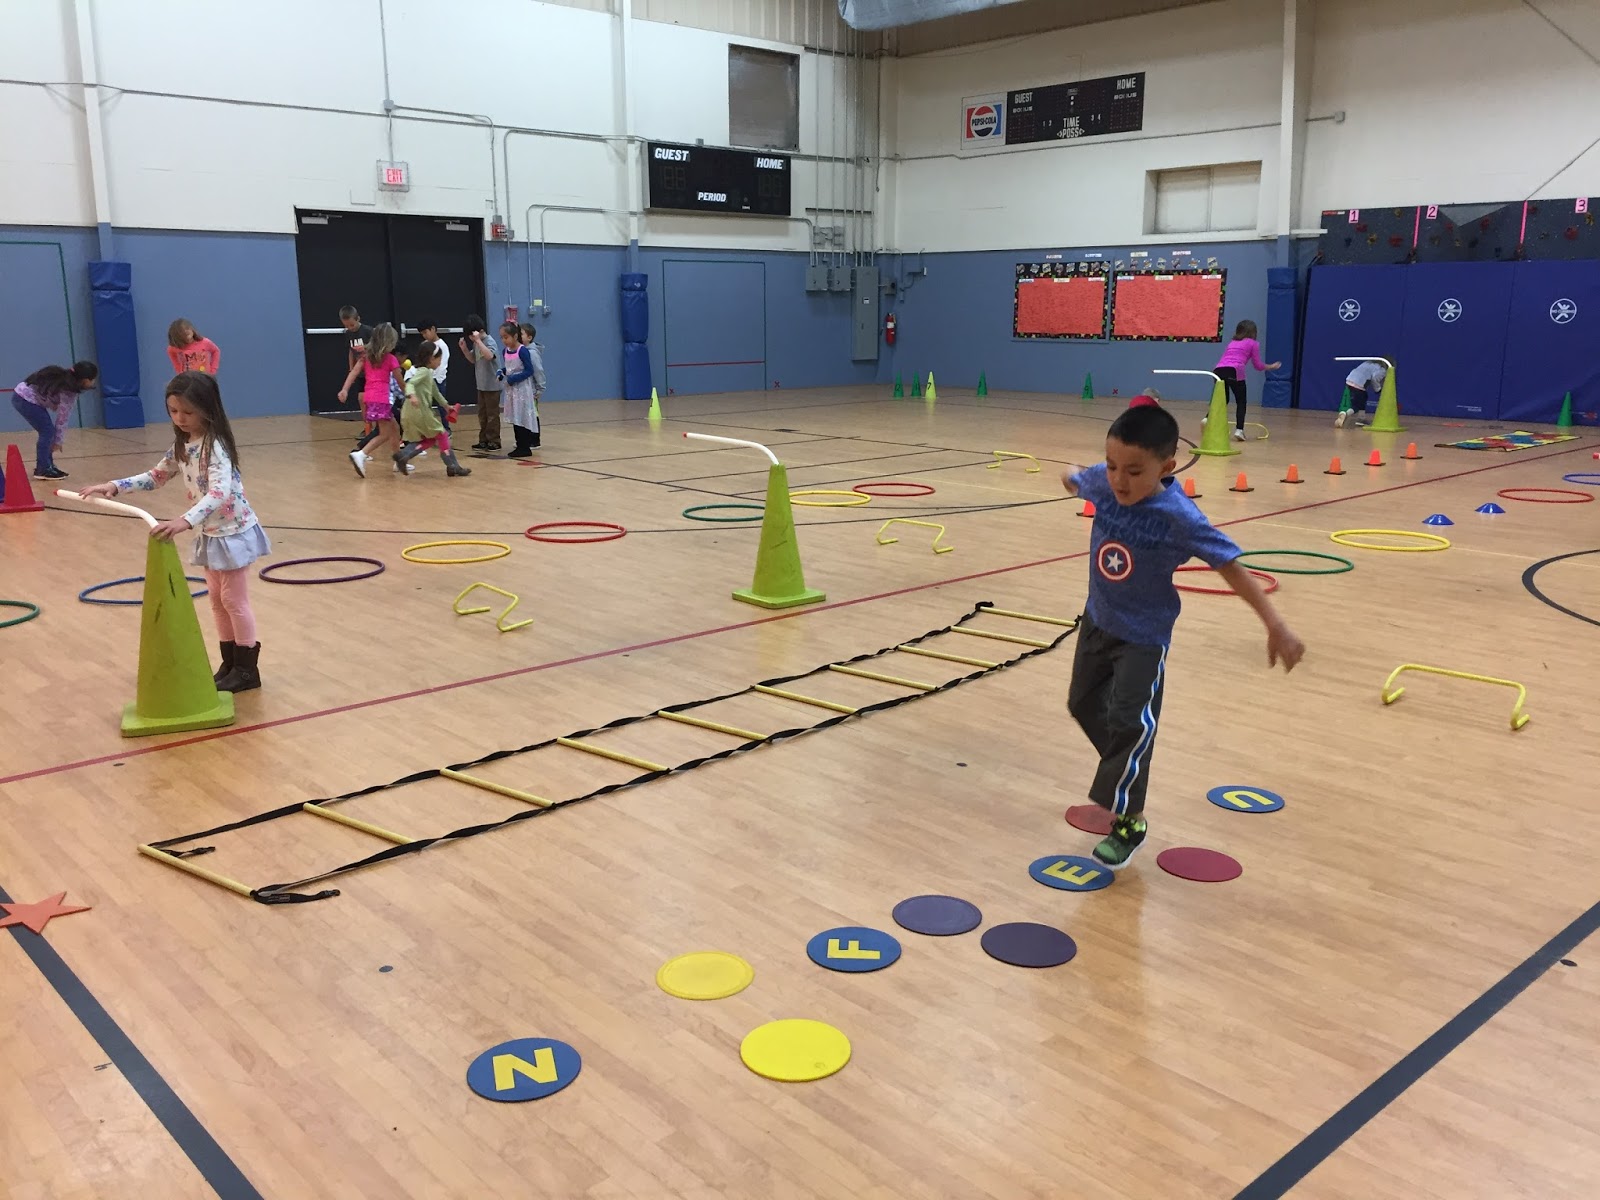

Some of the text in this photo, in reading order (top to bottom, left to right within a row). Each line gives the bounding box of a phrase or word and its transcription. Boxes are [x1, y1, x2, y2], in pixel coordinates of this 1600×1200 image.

[1116, 77, 1137, 90] HOME
[1014, 92, 1033, 104] GUEST
[1063, 116, 1080, 128] TIME
[654, 147, 689, 161] GUEST
[756, 157, 784, 170] HOME
[697, 191, 727, 202] PERIOD
[1427, 206, 1436, 218] 2
[1577, 199, 1586, 212] 3
[1351, 210, 1358, 222] 1
[1041, 860, 1102, 886] E
[826, 938, 881, 960] F
[492, 1047, 559, 1092] N
